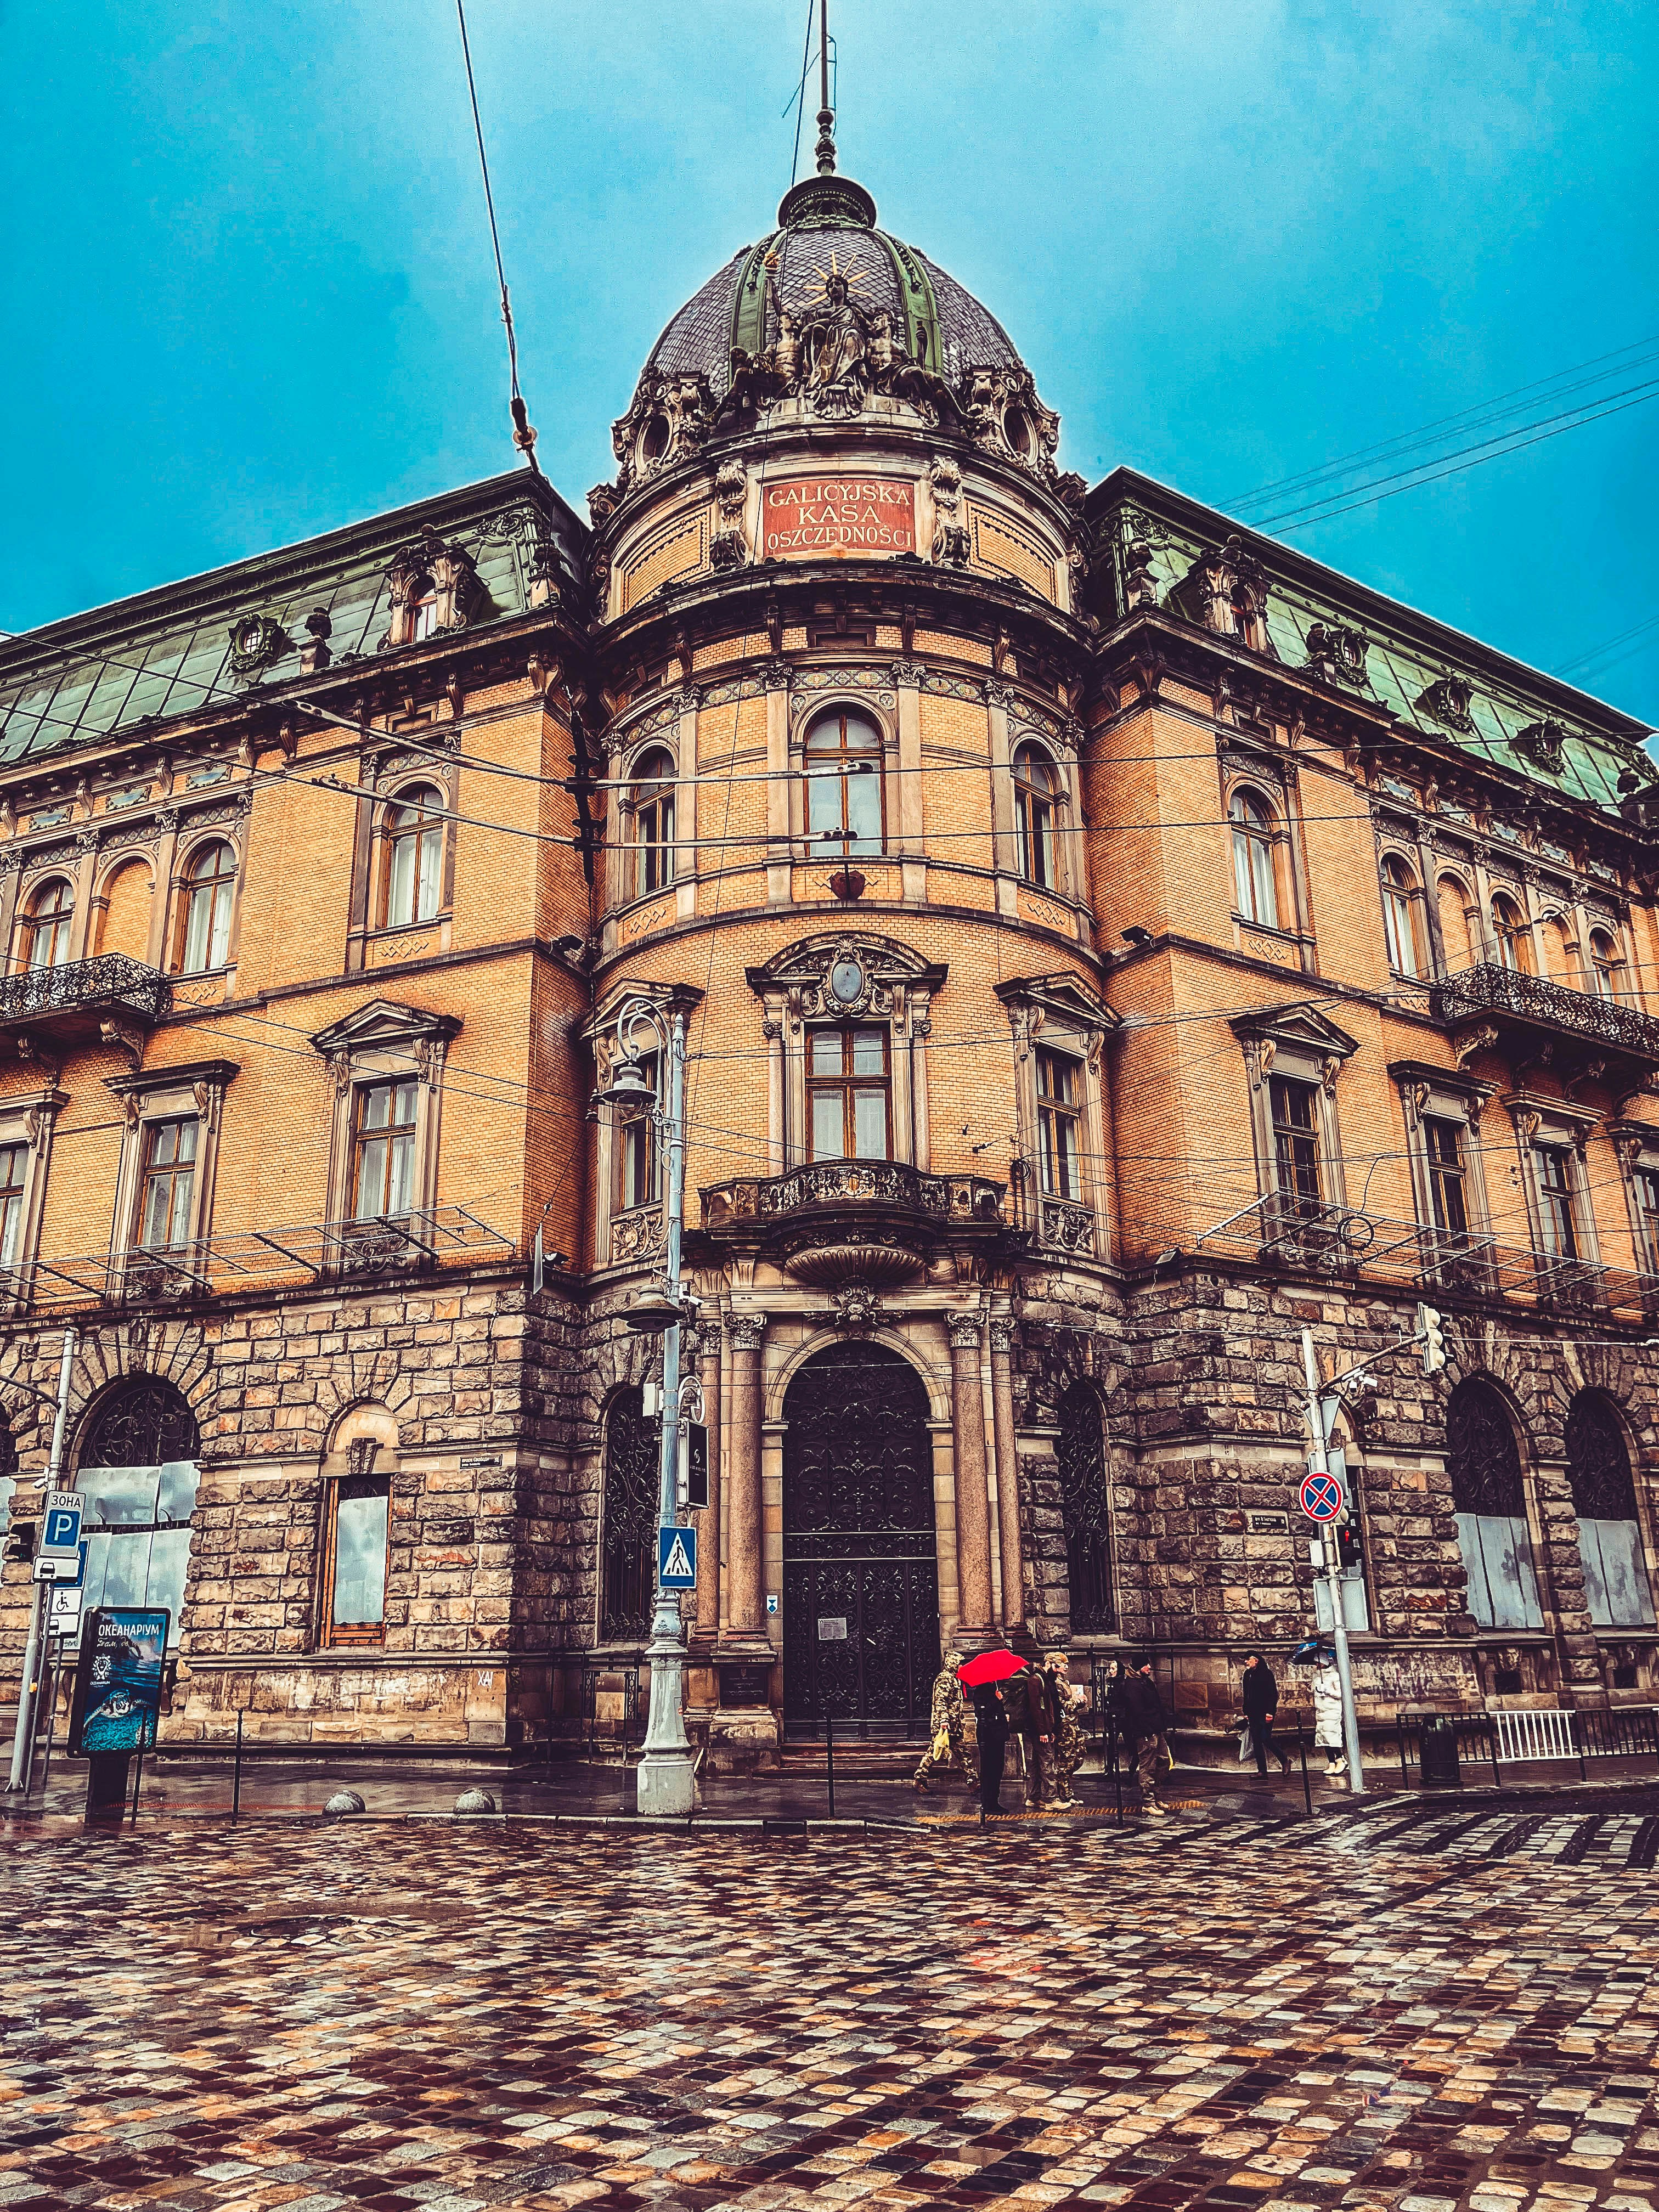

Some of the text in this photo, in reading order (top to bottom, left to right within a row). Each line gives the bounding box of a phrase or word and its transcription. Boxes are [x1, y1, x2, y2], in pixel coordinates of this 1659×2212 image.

[769, 484, 911, 507] GALICYJSKA
[798, 504, 881, 525] KASA
[51, 1495, 81, 1508] ЗОНА
[54, 1514, 72, 1541] P
[99, 1624, 159, 1636] ОКЕАНАРІУМ
